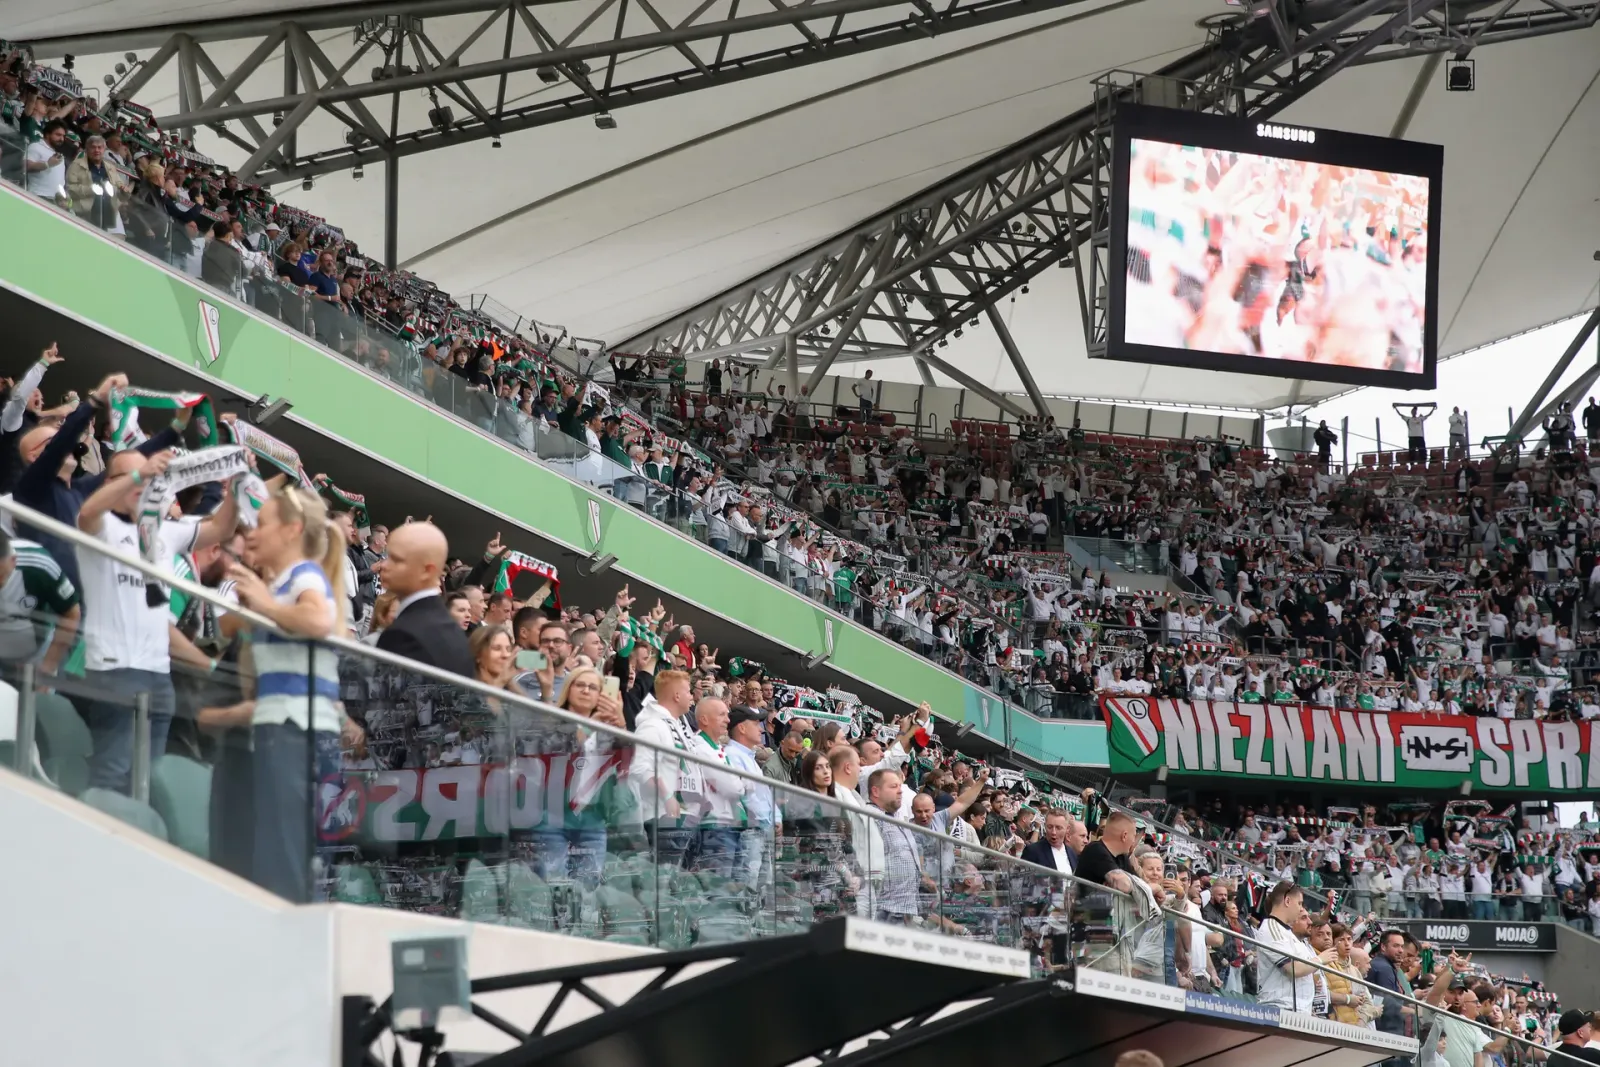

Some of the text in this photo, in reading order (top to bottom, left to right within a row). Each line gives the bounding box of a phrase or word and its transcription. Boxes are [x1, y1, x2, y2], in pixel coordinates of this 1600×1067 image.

[1256, 123, 1316, 144] SAMSUNG
[1157, 698, 1396, 783] NIEZNANI
[678, 776, 696, 791] 1916
